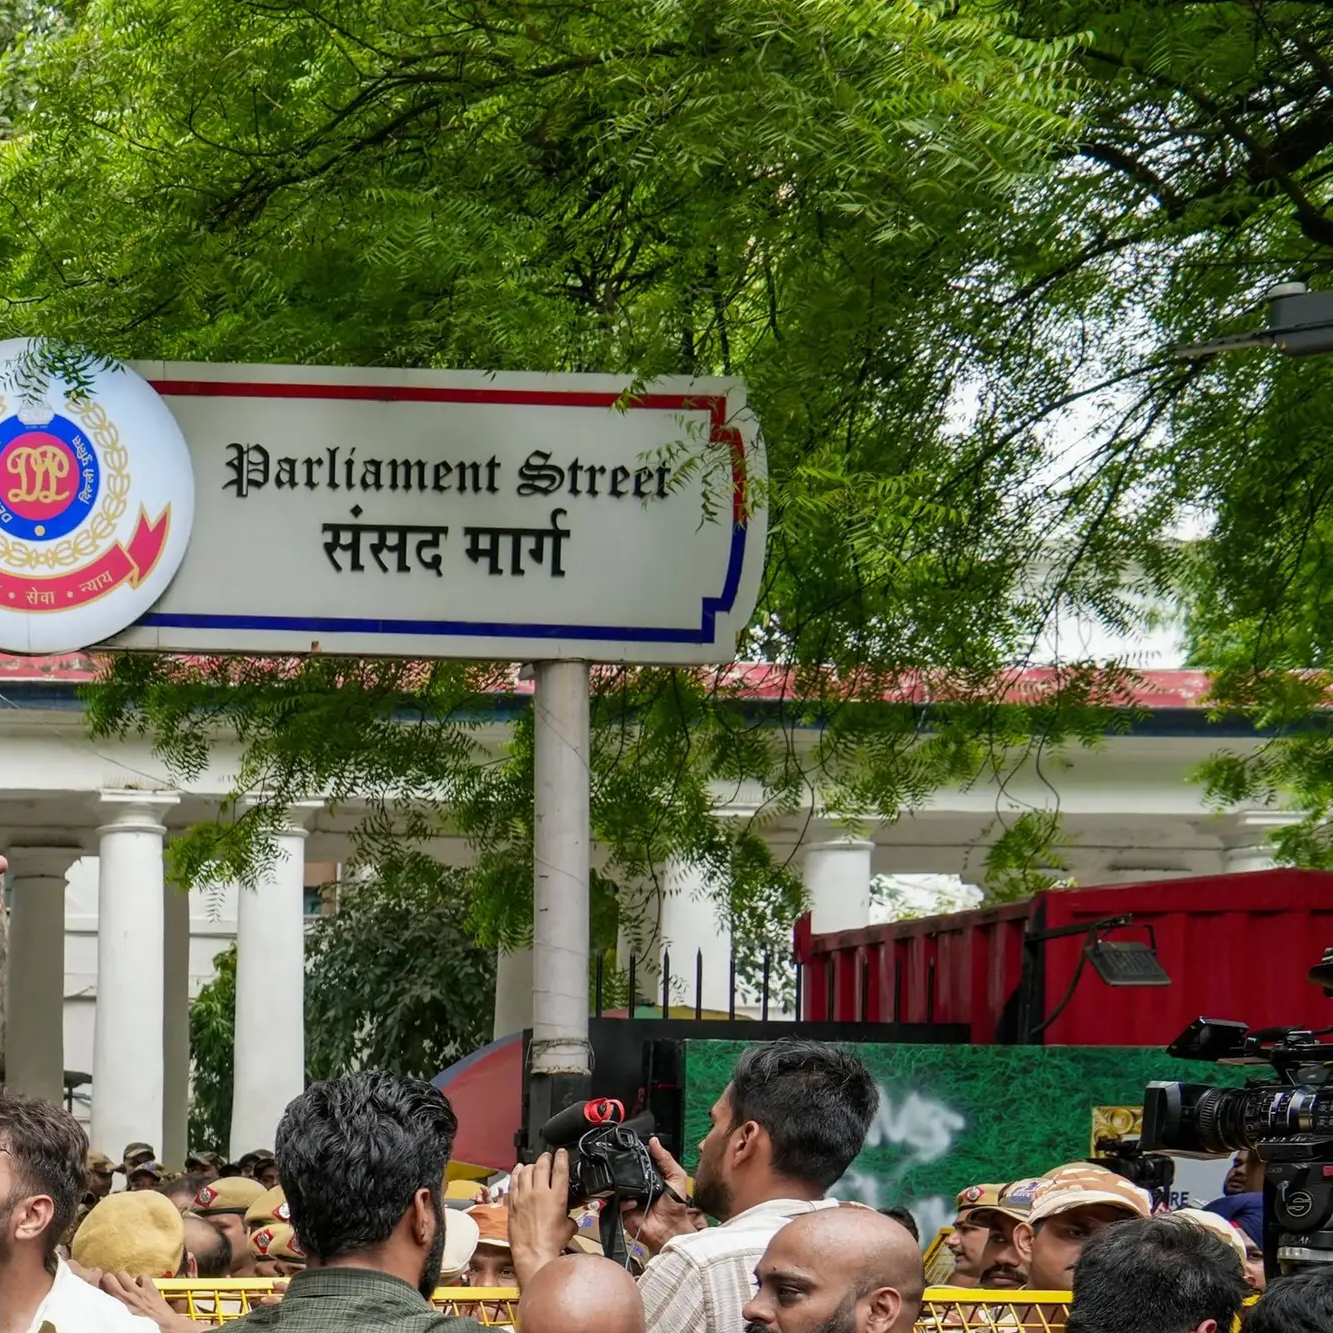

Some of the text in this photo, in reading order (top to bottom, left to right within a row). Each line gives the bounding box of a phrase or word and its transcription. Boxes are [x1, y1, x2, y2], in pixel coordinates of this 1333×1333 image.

[222, 443, 672, 499] Parliament Street
[321, 504, 571, 578] संसद मार्ग
[25, 586, 55, 605] सेवा
[79, 570, 113, 593] न्याय
[1169, 1191, 1190, 1207] RE
